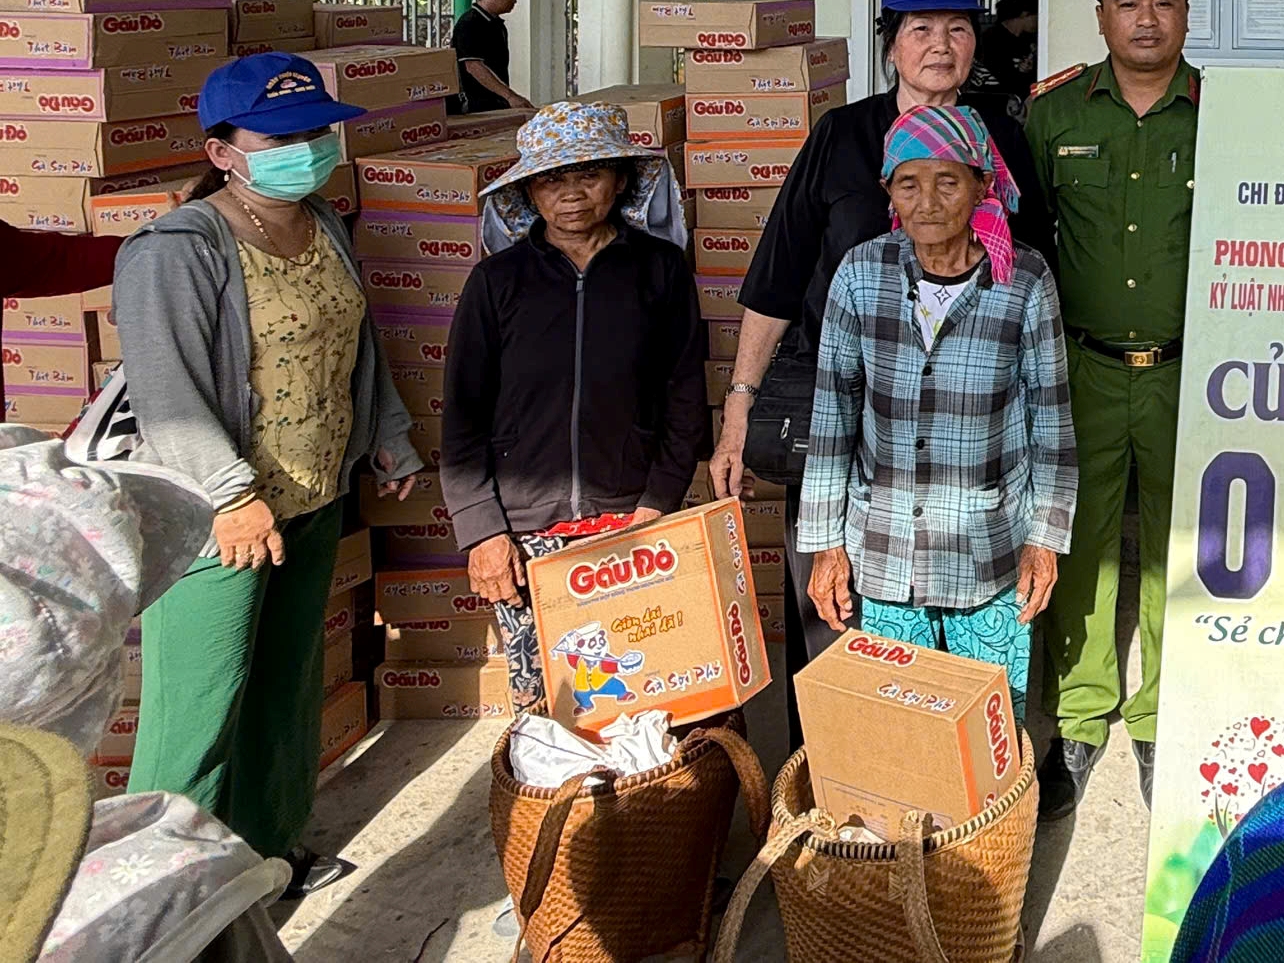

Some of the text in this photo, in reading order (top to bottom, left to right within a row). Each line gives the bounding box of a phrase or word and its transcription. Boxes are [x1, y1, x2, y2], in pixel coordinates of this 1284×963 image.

[694, 101, 723, 115] Gấu
[725, 100, 744, 115] Đỏ
[364, 167, 415, 184] Gấu Đỏ
[1238, 182, 1269, 204] CHI
[703, 237, 749, 251] Gấu Đỏ
[370, 272, 422, 288] Gấu Đỏ
[1209, 273, 1228, 309] KỶ
[1231, 278, 1264, 316] LUẬT
[1197, 451, 1275, 600] 0
[570, 556, 633, 594] Gấu
[632, 542, 675, 578] Đỏ
[848, 637, 915, 666] Gấu Đỏ
[384, 671, 440, 686] Gấu Đỏ
[986, 692, 1012, 777] Gấu Đỏ
